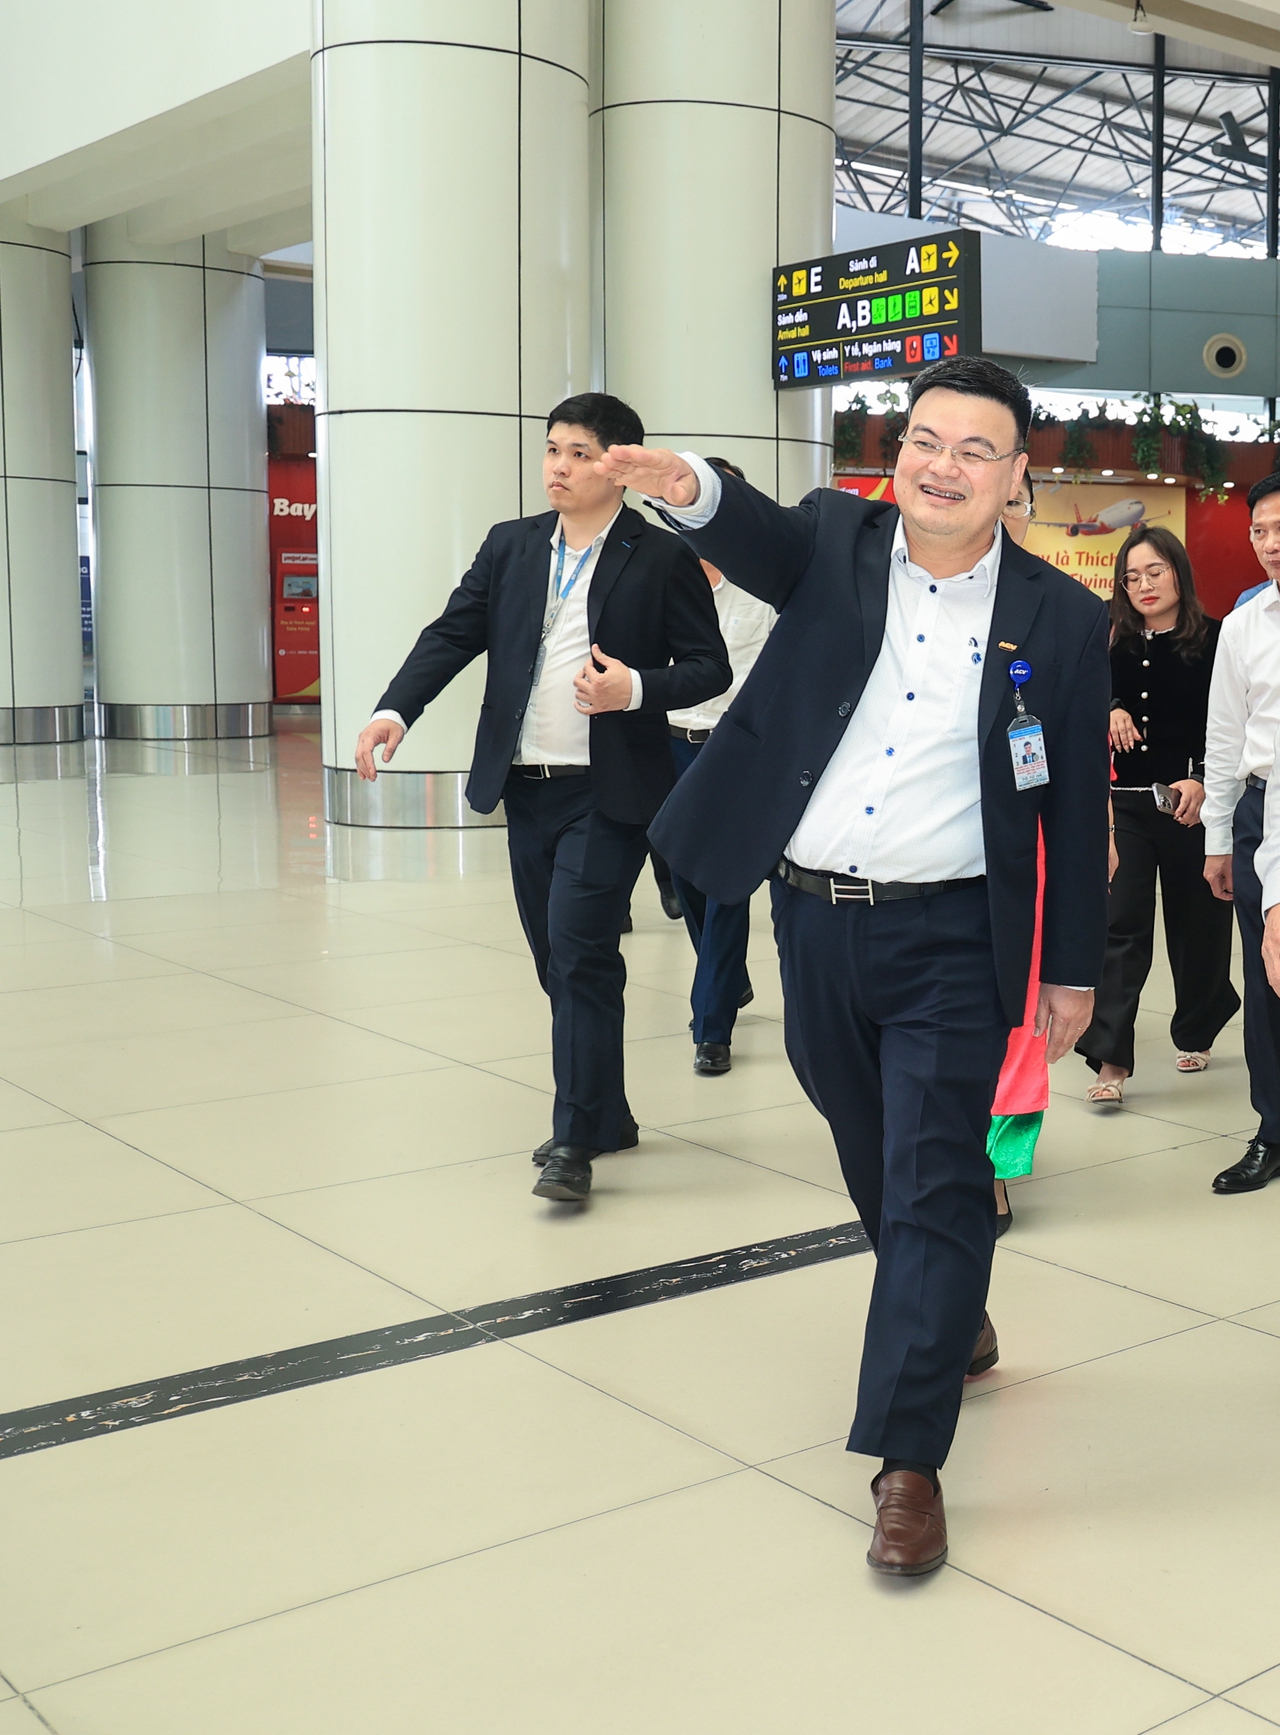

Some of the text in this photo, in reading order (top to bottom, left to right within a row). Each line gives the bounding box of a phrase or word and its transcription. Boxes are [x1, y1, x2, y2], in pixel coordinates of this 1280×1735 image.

[848, 255, 877, 272] Sảnh đi
[905, 246, 920, 275] A
[810, 266, 822, 293] E
[839, 269, 887, 290] Departure hall
[777, 308, 808, 326] Sảnh đến
[837, 299, 871, 333] A,B
[777, 325, 809, 341] Arrival hall
[811, 347, 838, 364] Vệ sinh
[844, 345, 851, 357] Y
[862, 341, 882, 357] Ngân
[882, 339, 901, 353] hàng
[817, 365, 839, 376] Toilets
[844, 361, 860, 374] First
[874, 356, 893, 369] Bank
[273, 498, 317, 520] Bay
[1055, 550, 1070, 566] là
